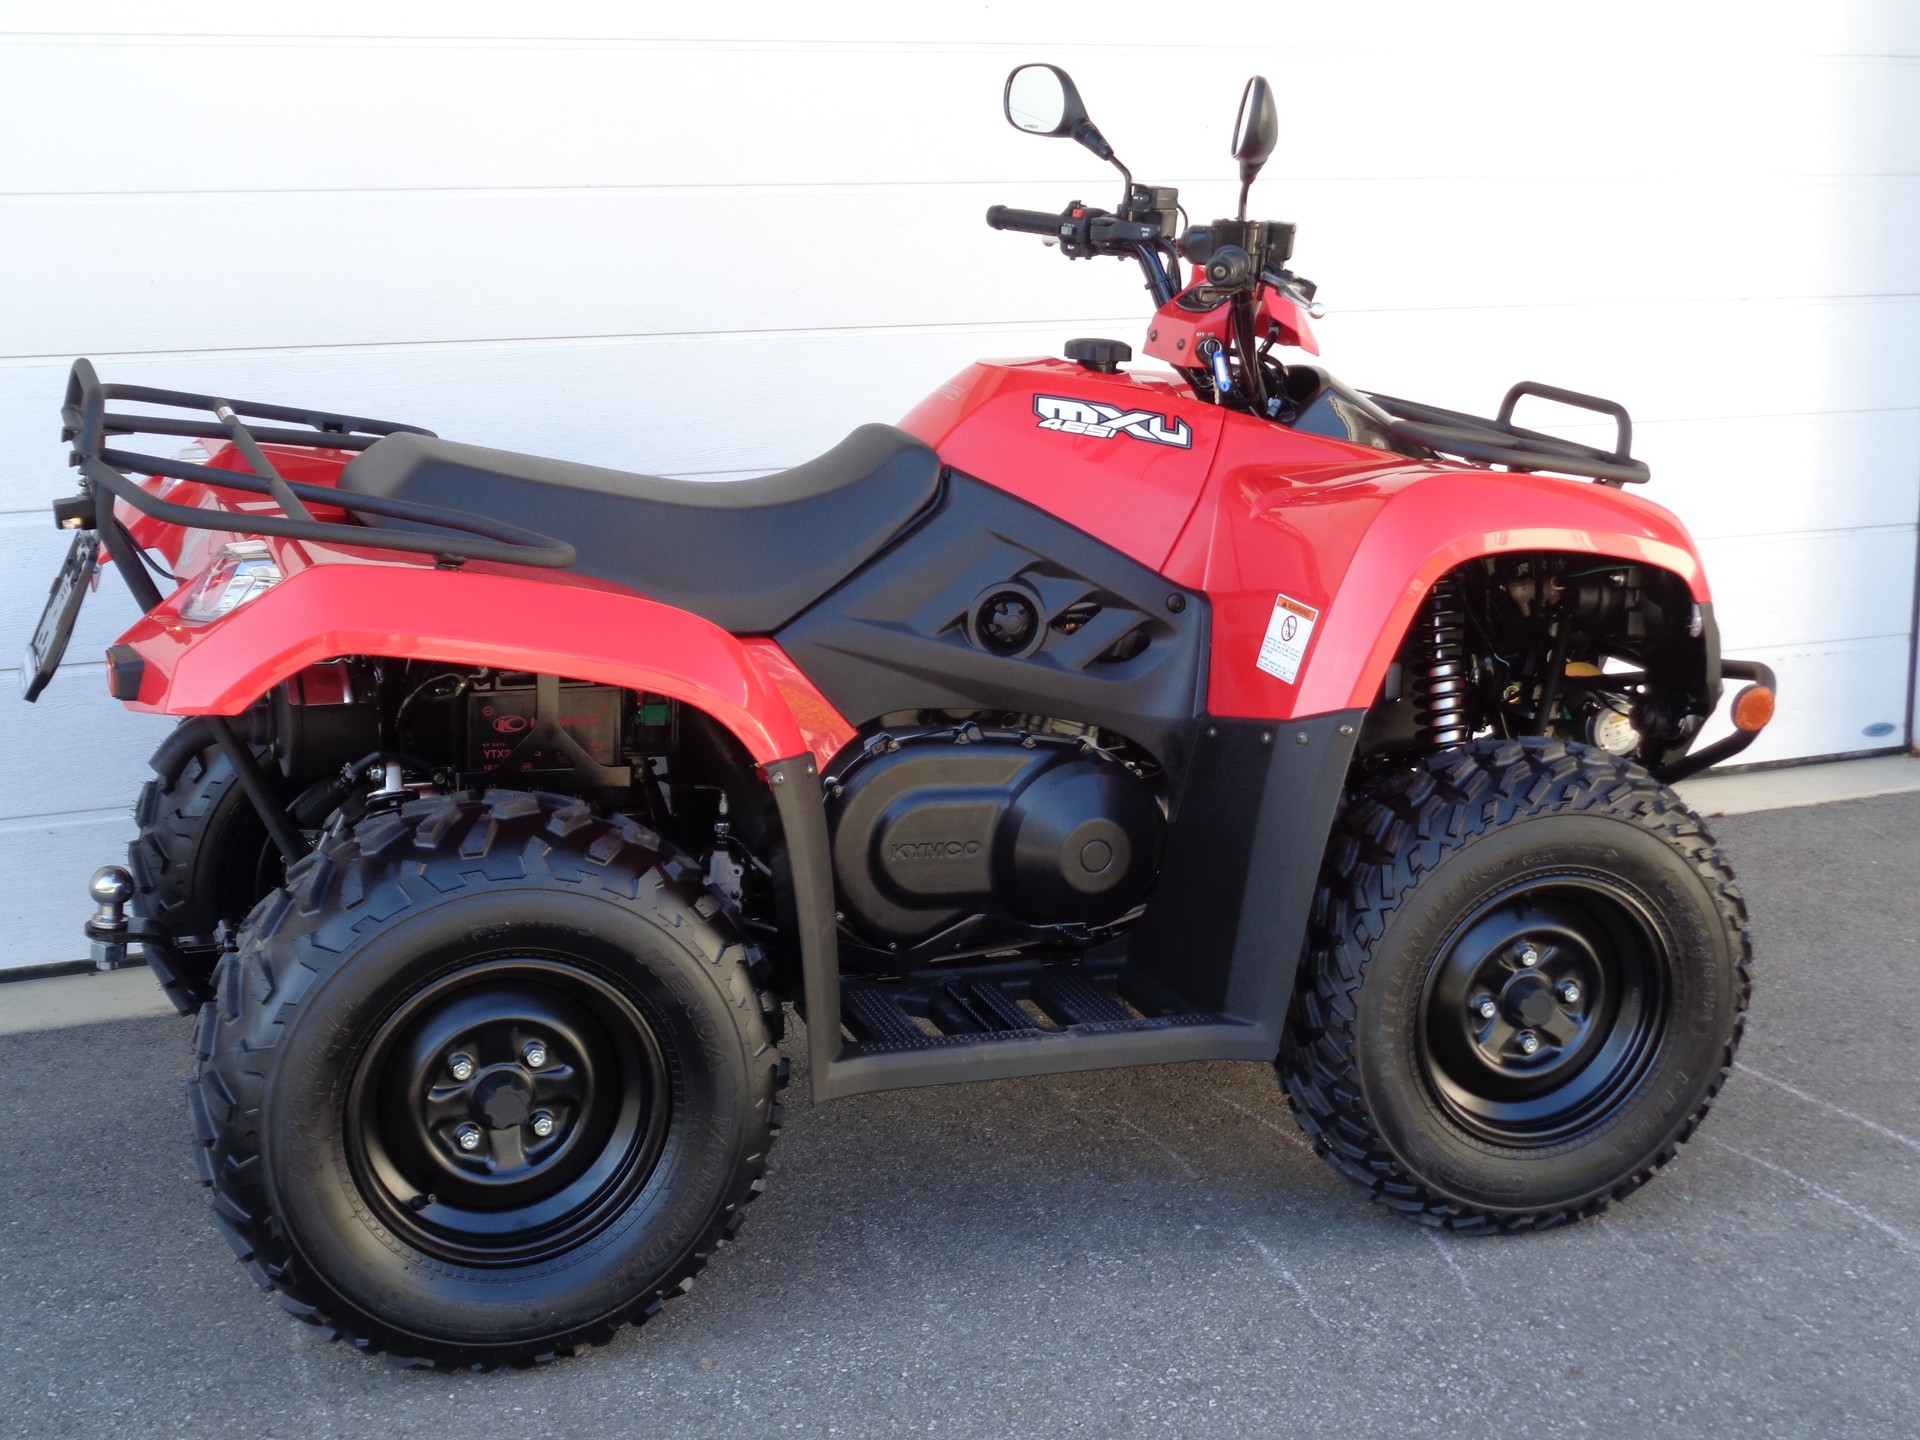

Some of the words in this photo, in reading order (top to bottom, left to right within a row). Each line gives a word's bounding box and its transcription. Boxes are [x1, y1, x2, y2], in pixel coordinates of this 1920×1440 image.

[1033, 393, 1192, 449] MXU
[1287, 603, 1311, 618] WARNING
[891, 840, 982, 861] KYMCO
